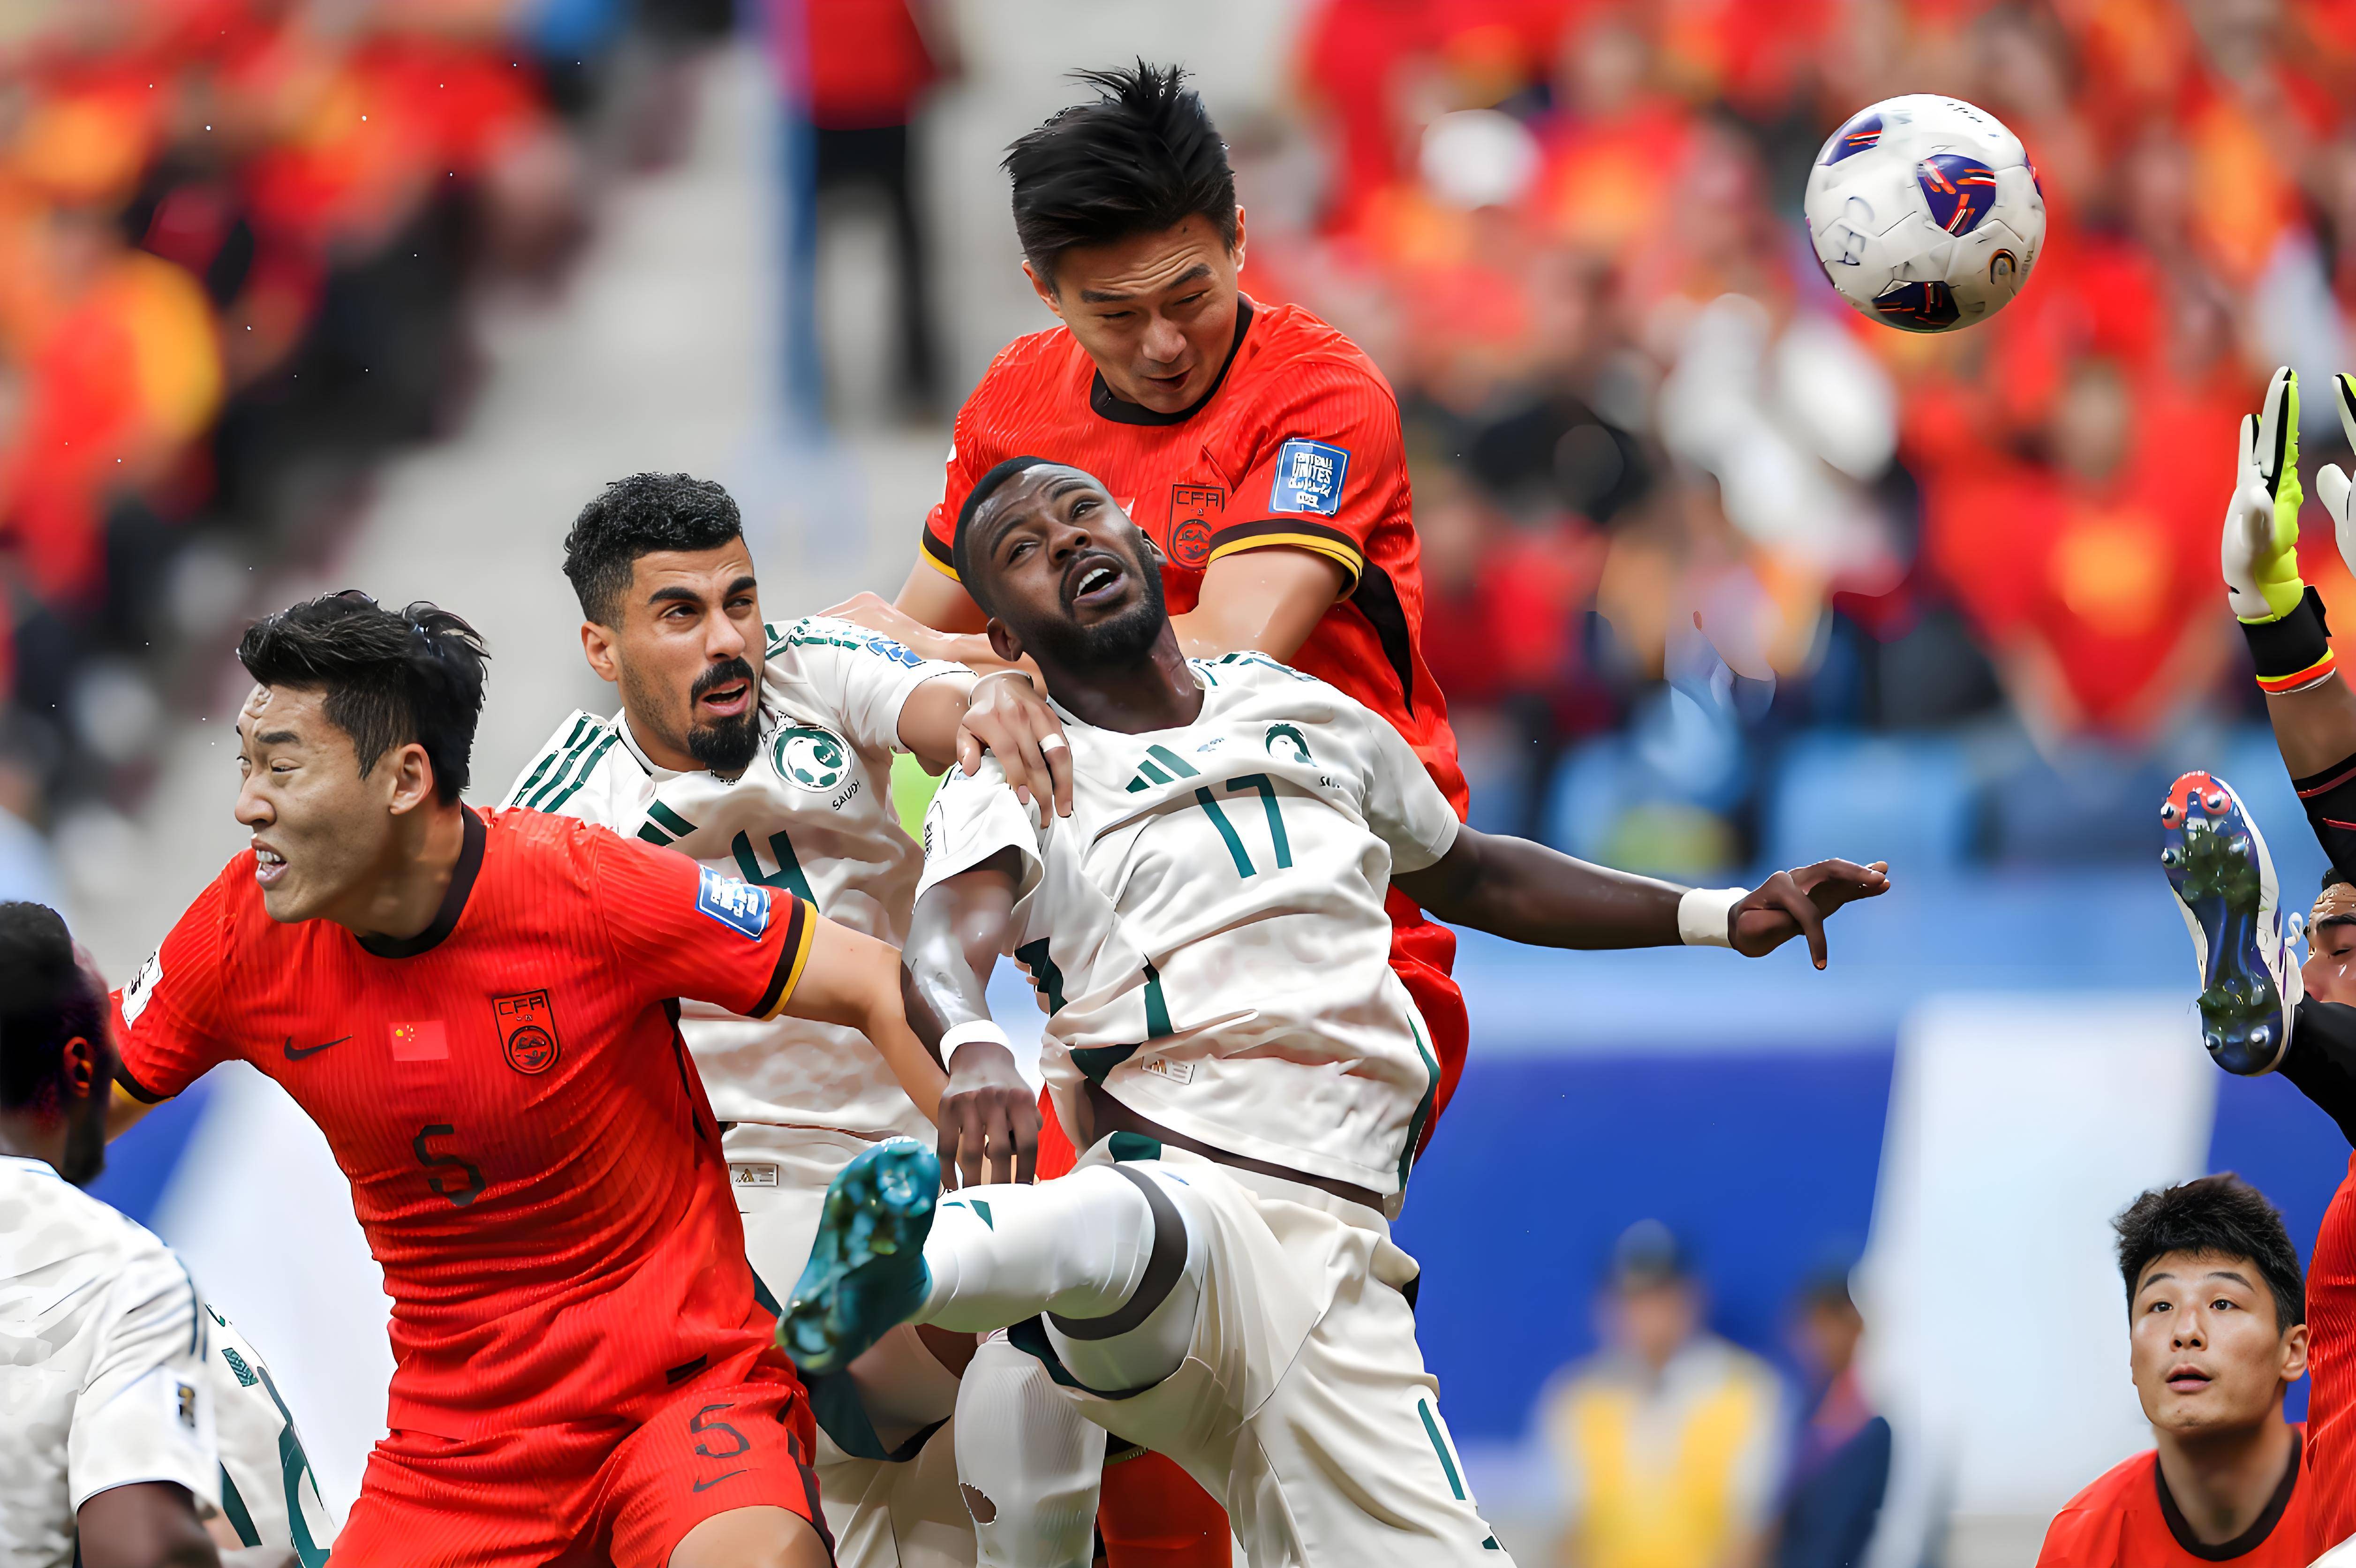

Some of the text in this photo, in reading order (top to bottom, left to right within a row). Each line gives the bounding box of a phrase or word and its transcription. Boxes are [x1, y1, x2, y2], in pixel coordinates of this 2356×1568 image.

[1177, 490, 1218, 507] CFA
[1292, 463, 1332, 484] UNITES
[1194, 773, 1292, 879] 17
[732, 829, 820, 913] 4
[498, 996, 544, 1016] CFA
[413, 1124, 486, 1207] 5
[690, 1403, 750, 1458] 5
